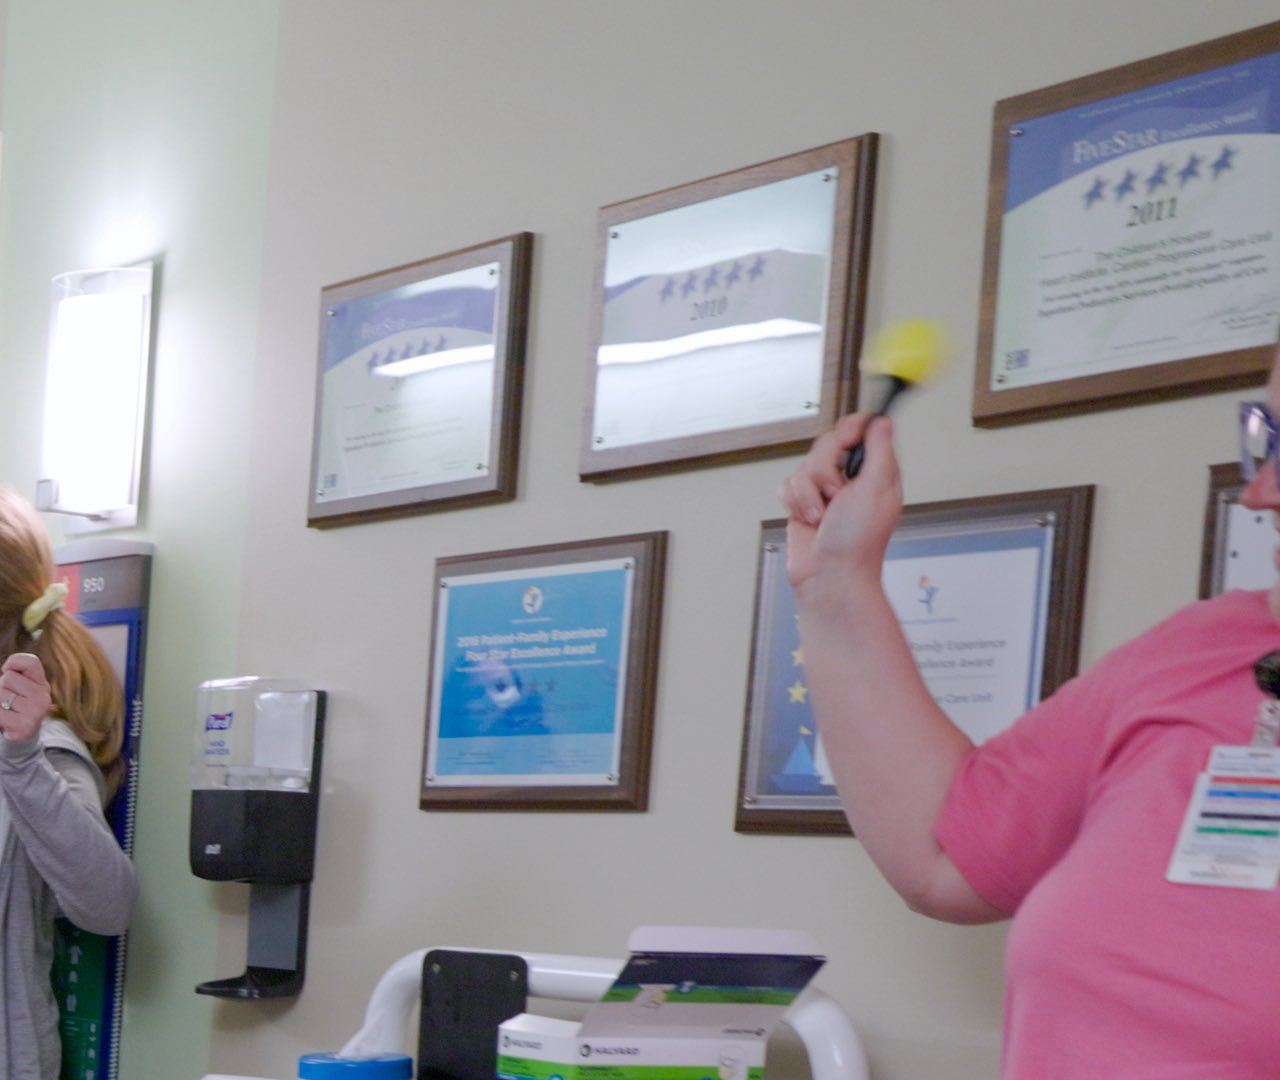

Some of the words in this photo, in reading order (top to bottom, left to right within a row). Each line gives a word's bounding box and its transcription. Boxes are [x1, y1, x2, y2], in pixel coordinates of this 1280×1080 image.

[1126, 197, 1178, 227] 2011
[690, 296, 729, 321] 2010
[83, 576, 105, 592] 950
[510, 646, 561, 659] Excellence
[563, 642, 597, 654] Award
